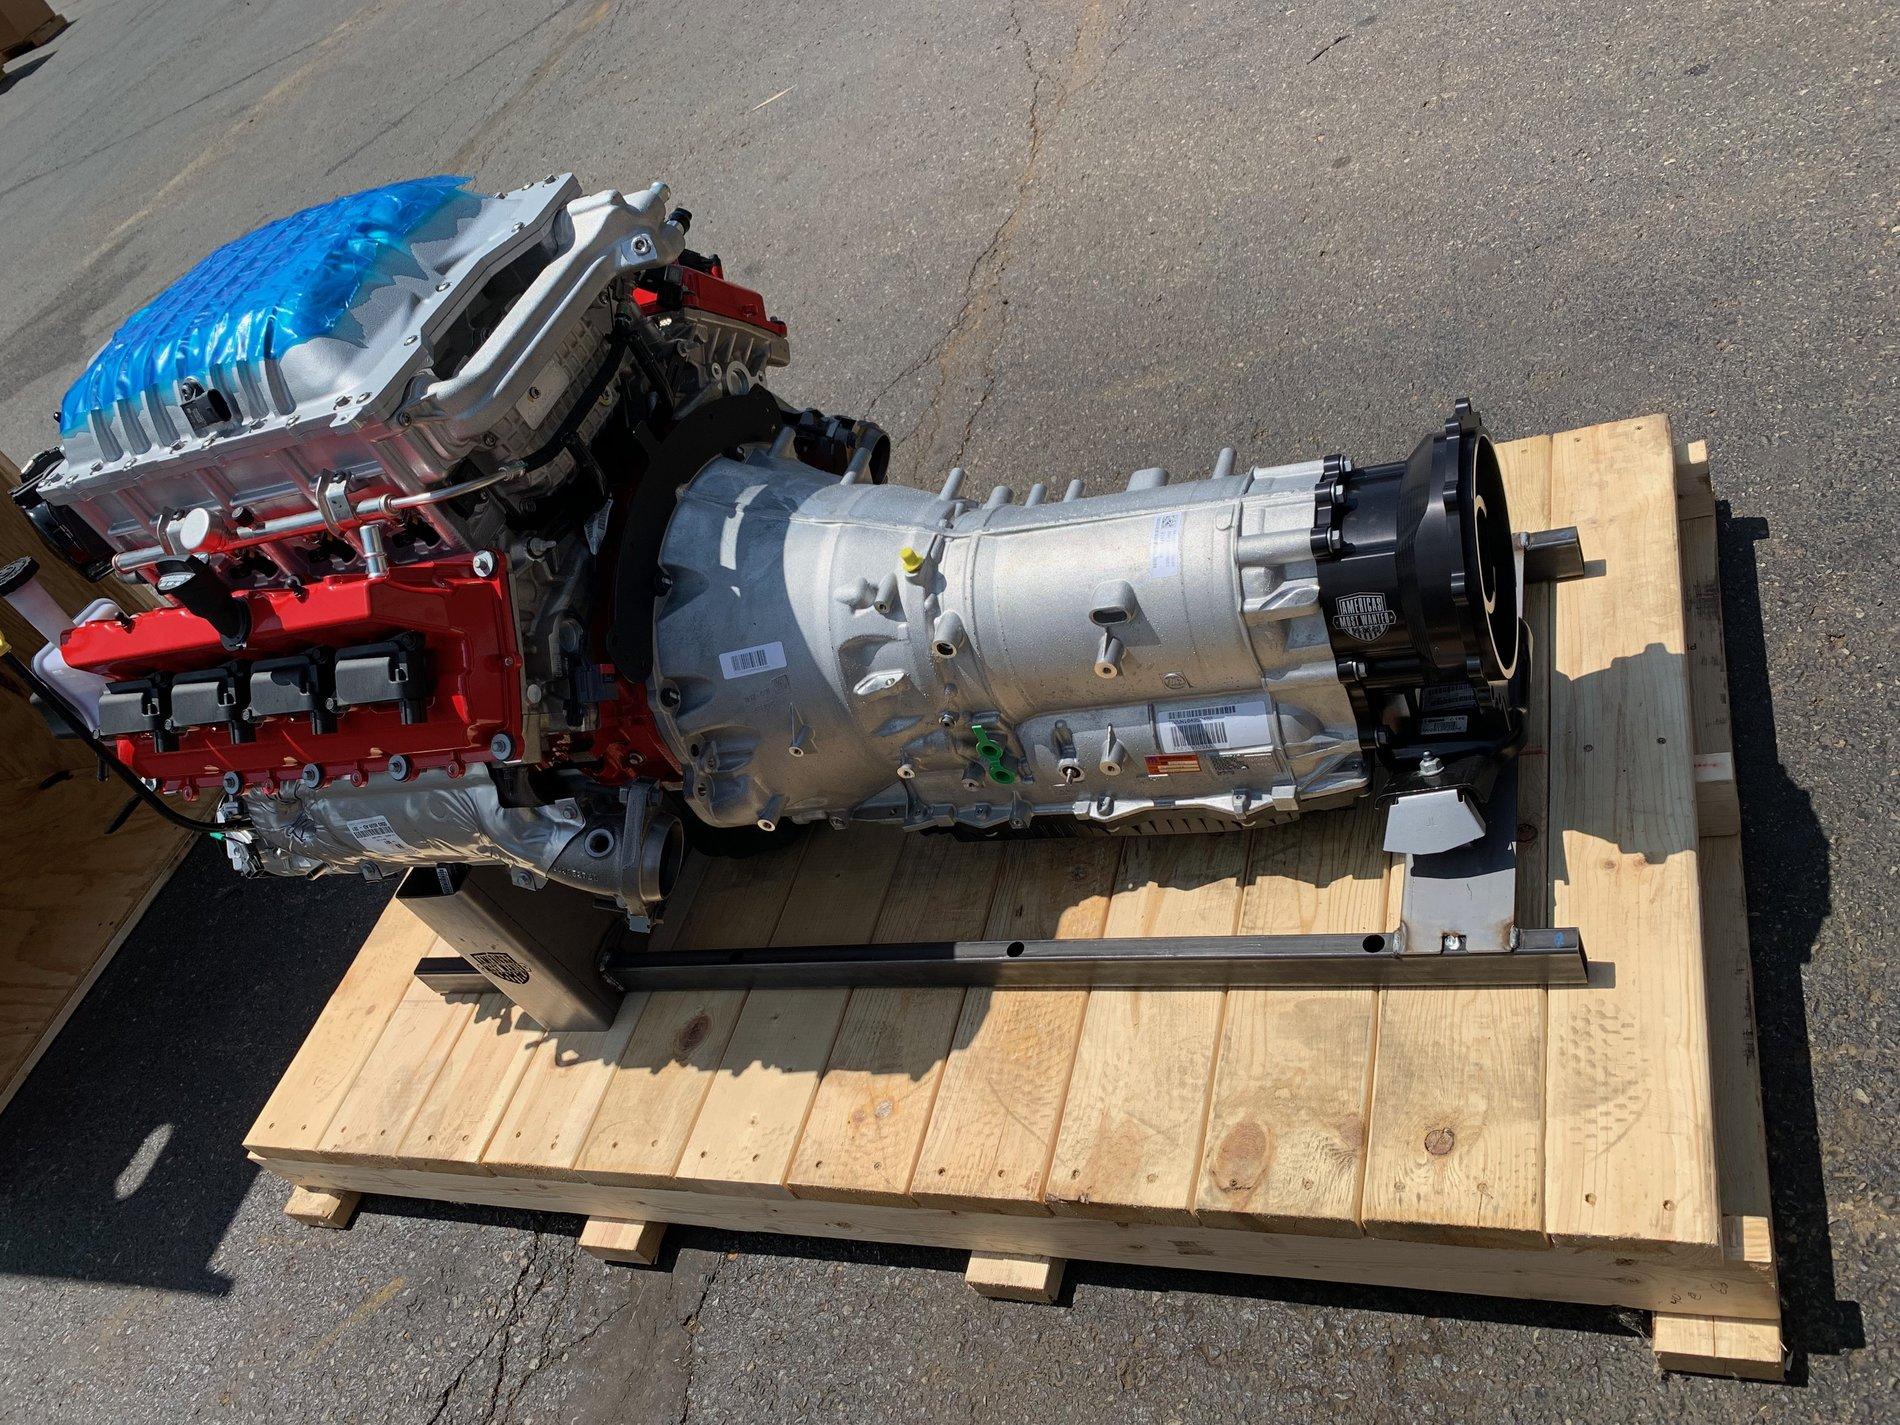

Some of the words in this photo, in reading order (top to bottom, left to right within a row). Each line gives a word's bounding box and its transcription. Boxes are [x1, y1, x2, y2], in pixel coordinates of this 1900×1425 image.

[1341, 597, 1382, 615] AMERICAS
[1339, 616, 1359, 628] MOST
[1360, 612, 1390, 625] WANTED
